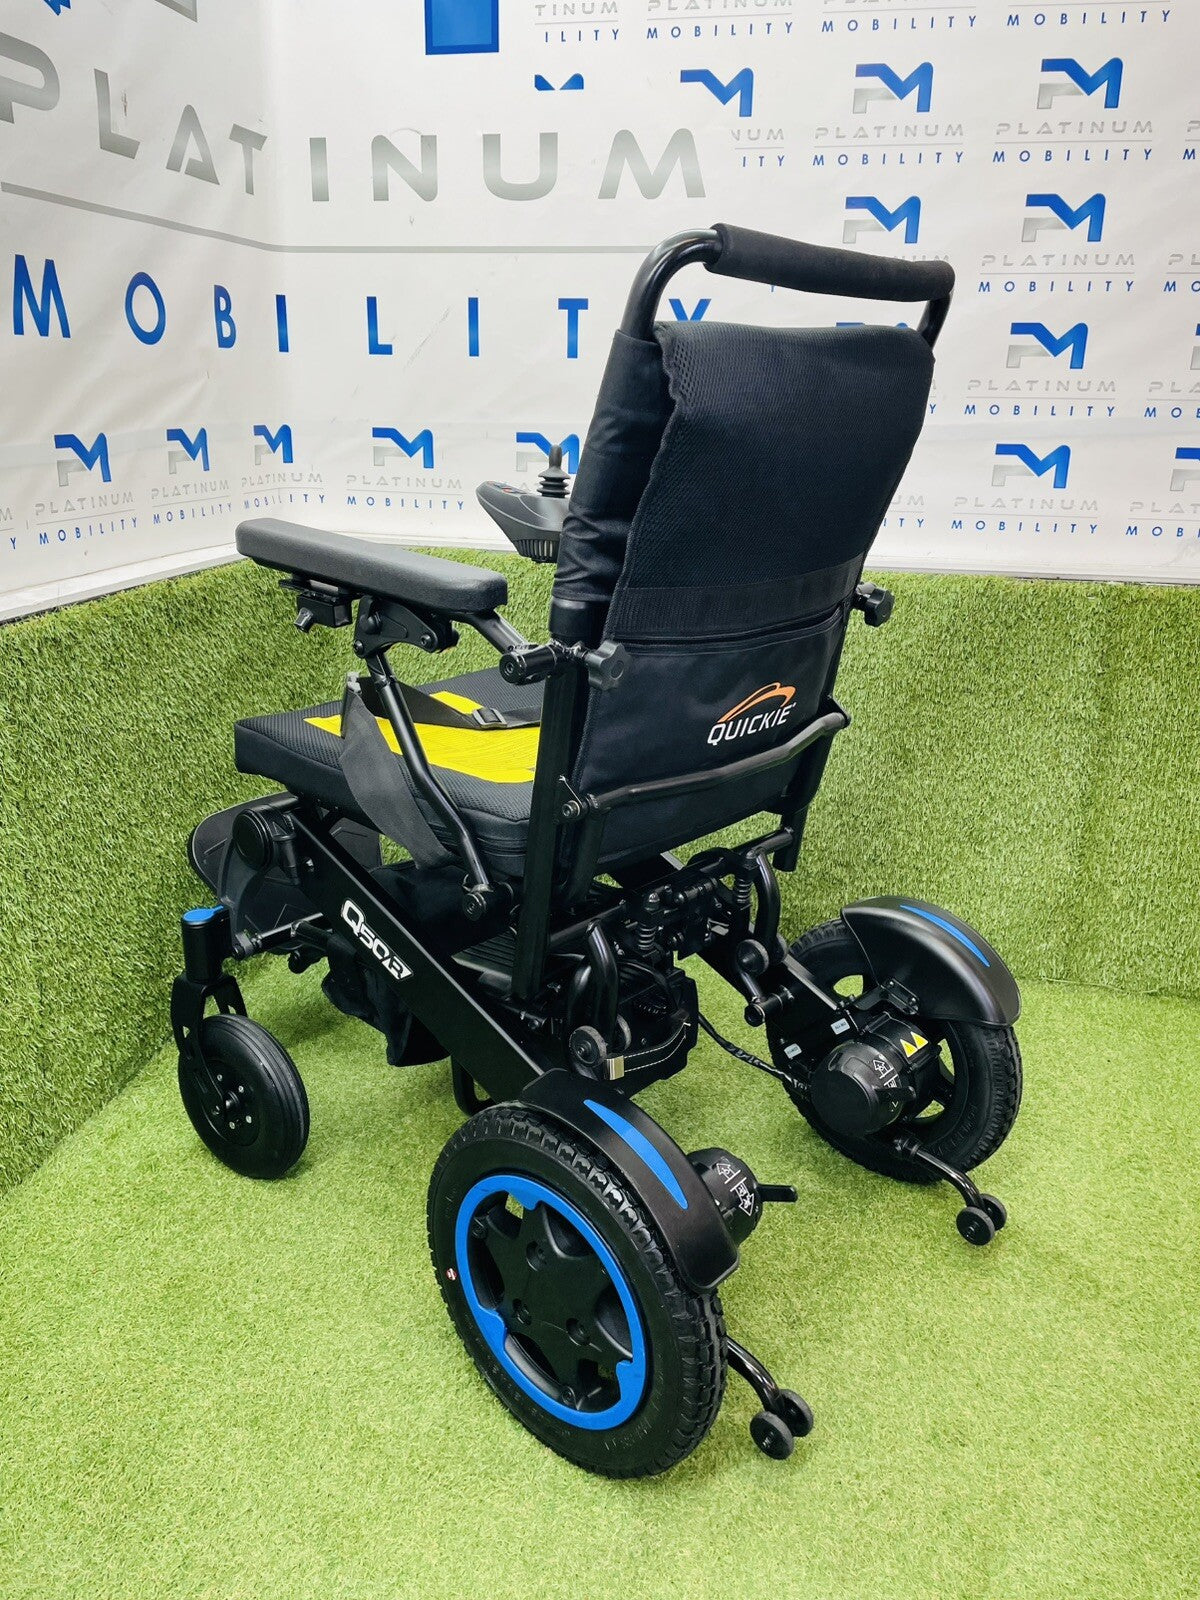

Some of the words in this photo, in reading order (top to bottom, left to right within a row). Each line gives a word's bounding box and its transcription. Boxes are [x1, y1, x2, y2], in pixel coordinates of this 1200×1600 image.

[822, 15, 976, 32] MOBILITY
[1007, 10, 1171, 26] MOBILITY
[646, 22, 793, 39] MOBILITY
[815, 123, 964, 140] PLATINUM
[996, 120, 1153, 136] PLATINUM
[812, 152, 964, 166] MOBILITY
[993, 149, 1152, 163] MOBILITY
[981, 253, 1136, 267] PLATINUM
[978, 280, 1135, 293] MOBILITY
[967, 379, 1117, 393] PLATINUM
[963, 404, 1115, 418] MOBILITY
[241, 472, 322, 488] PLATINUM
[346, 475, 463, 490] PLATINUM
[152, 479, 230, 500] PLATINUM
[35, 491, 134, 517] PLATINUM
[346, 496, 465, 511] MOBILITY
[953, 496, 1098, 512] PLATINUM
[153, 502, 233, 525] MOBILITY
[39, 516, 138, 546] MOBILITY
[951, 519, 1097, 534] MOBILITY
[707, 704, 792, 746] QUICKIE
